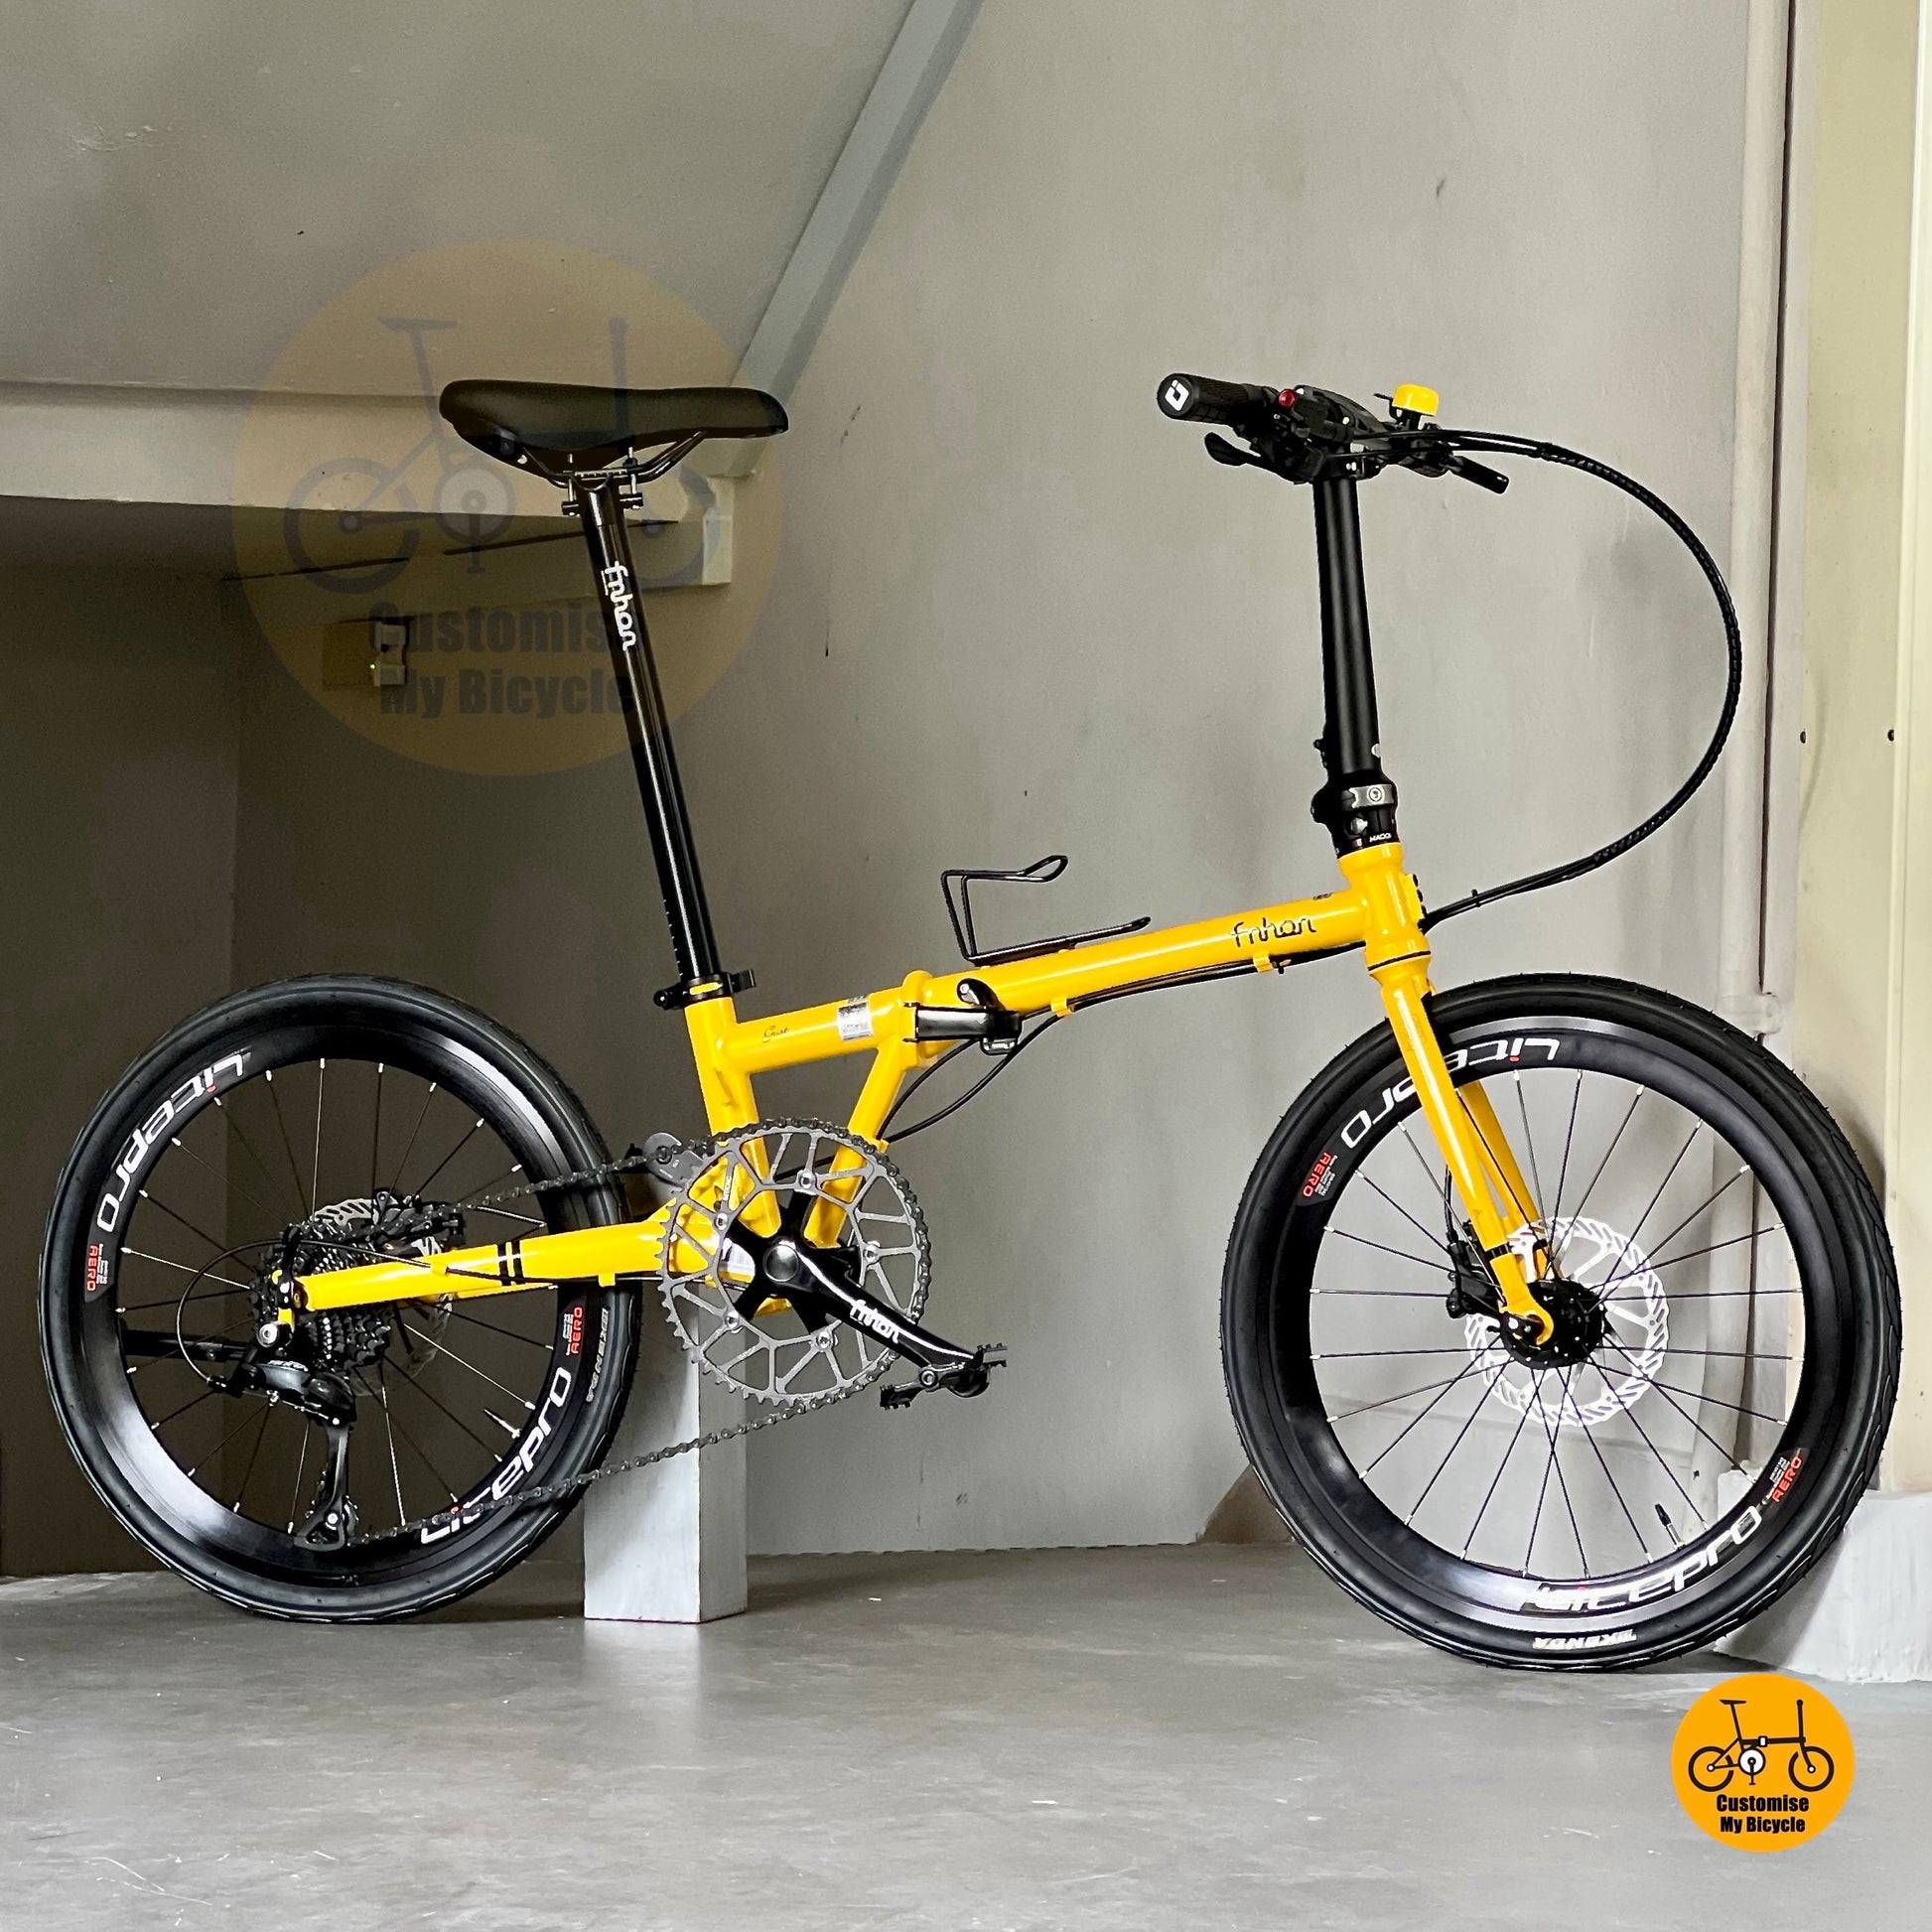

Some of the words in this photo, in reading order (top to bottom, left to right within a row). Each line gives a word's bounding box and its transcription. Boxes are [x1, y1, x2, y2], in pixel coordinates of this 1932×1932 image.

[1303, 1152, 1332, 1197] AERO
[86, 1245, 100, 1292] AERO
[570, 1307, 583, 1354] AERO
[1771, 1454, 1803, 1503] AERO
